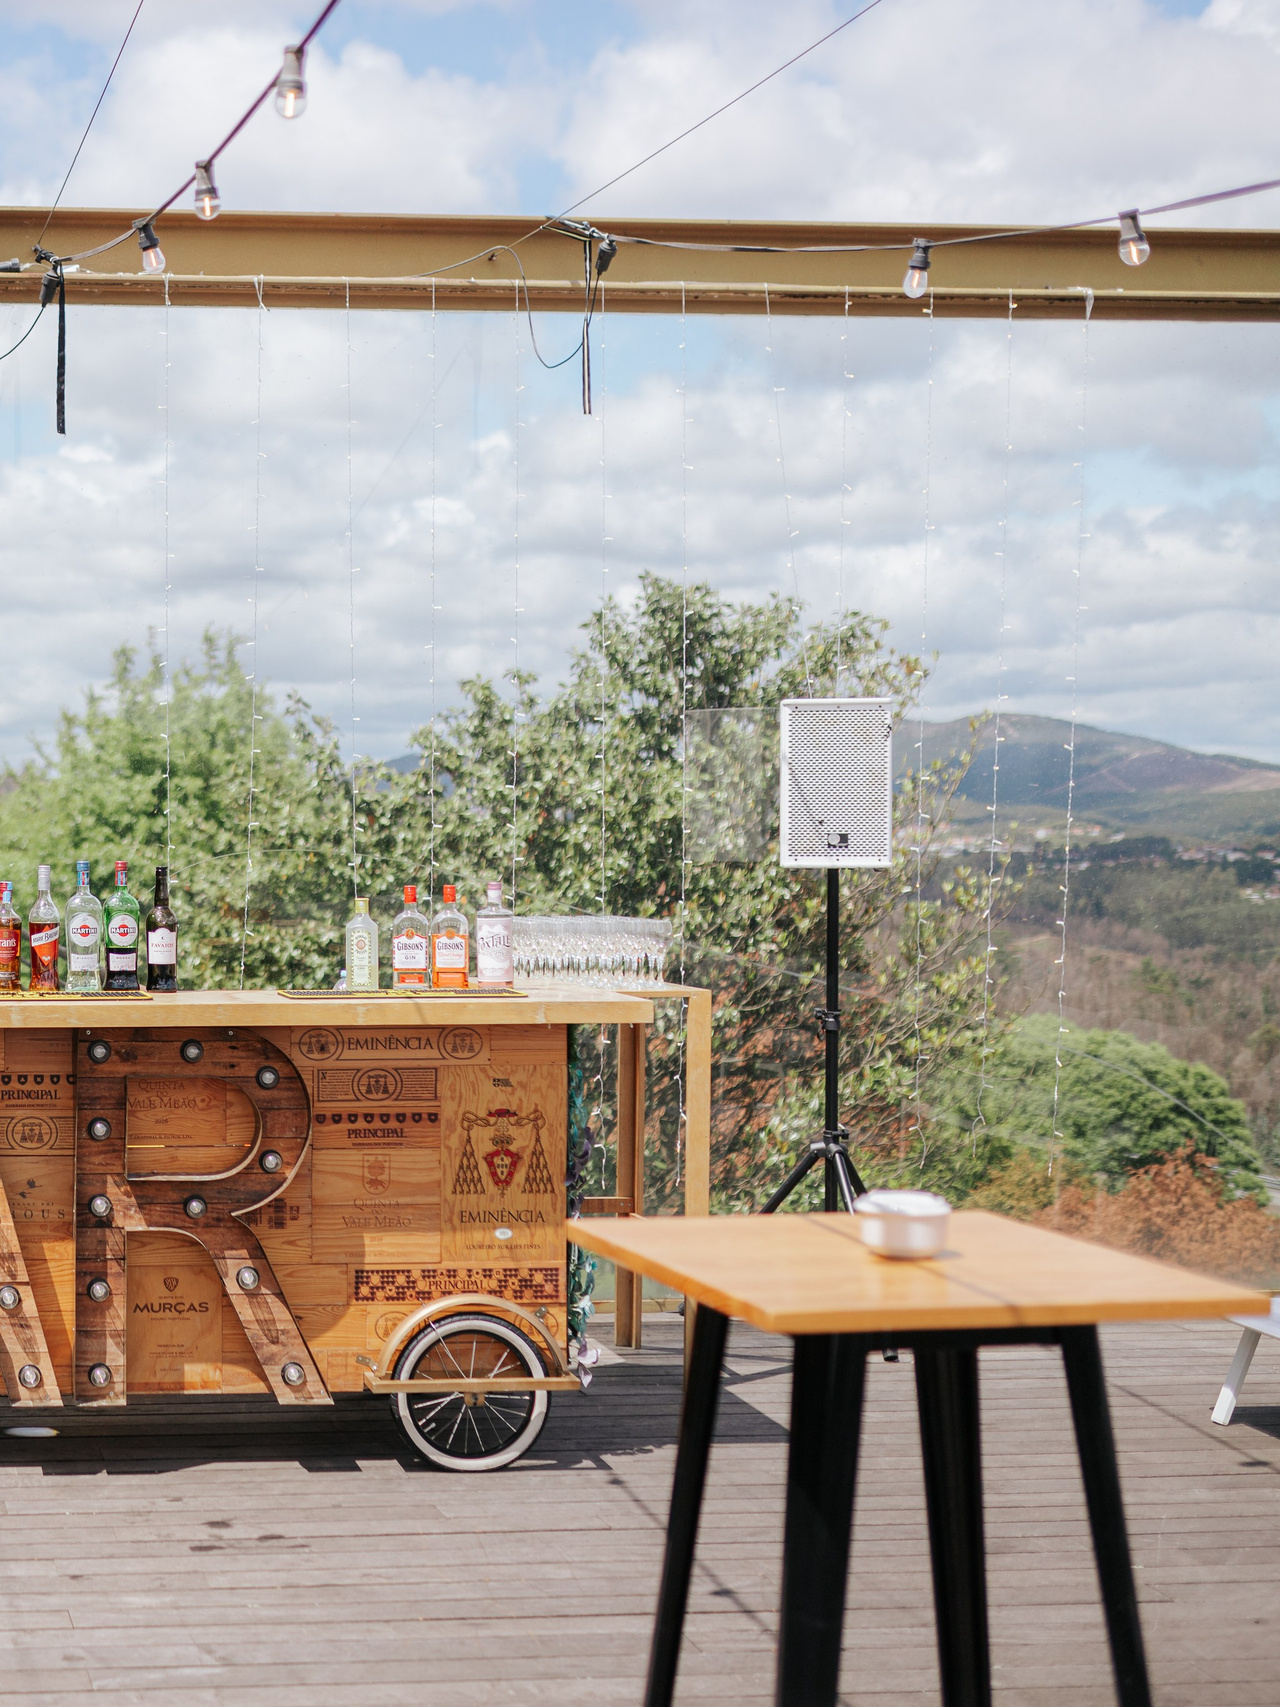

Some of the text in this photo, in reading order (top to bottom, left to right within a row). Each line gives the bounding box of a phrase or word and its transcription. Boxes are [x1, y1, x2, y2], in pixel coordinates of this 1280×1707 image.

[397, 942, 424, 951] GIBSON'S
[437, 941, 464, 951] GIBSON'S
[347, 1035, 434, 1051] EMINÊNCIA
[138, 1080, 185, 1093] QUINTA
[0, 1089, 61, 1100] PRINCIPAL
[127, 1097, 197, 1109] VALE MEÃO
[347, 1128, 408, 1139] PRINCIPAL
[10, 1209, 66, 1220] ROUS
[460, 1207, 546, 1224] EMINÊNCIA
[428, 1279, 488, 1291] PRINCIPAL
[132, 1301, 210, 1315] MURÇAS
